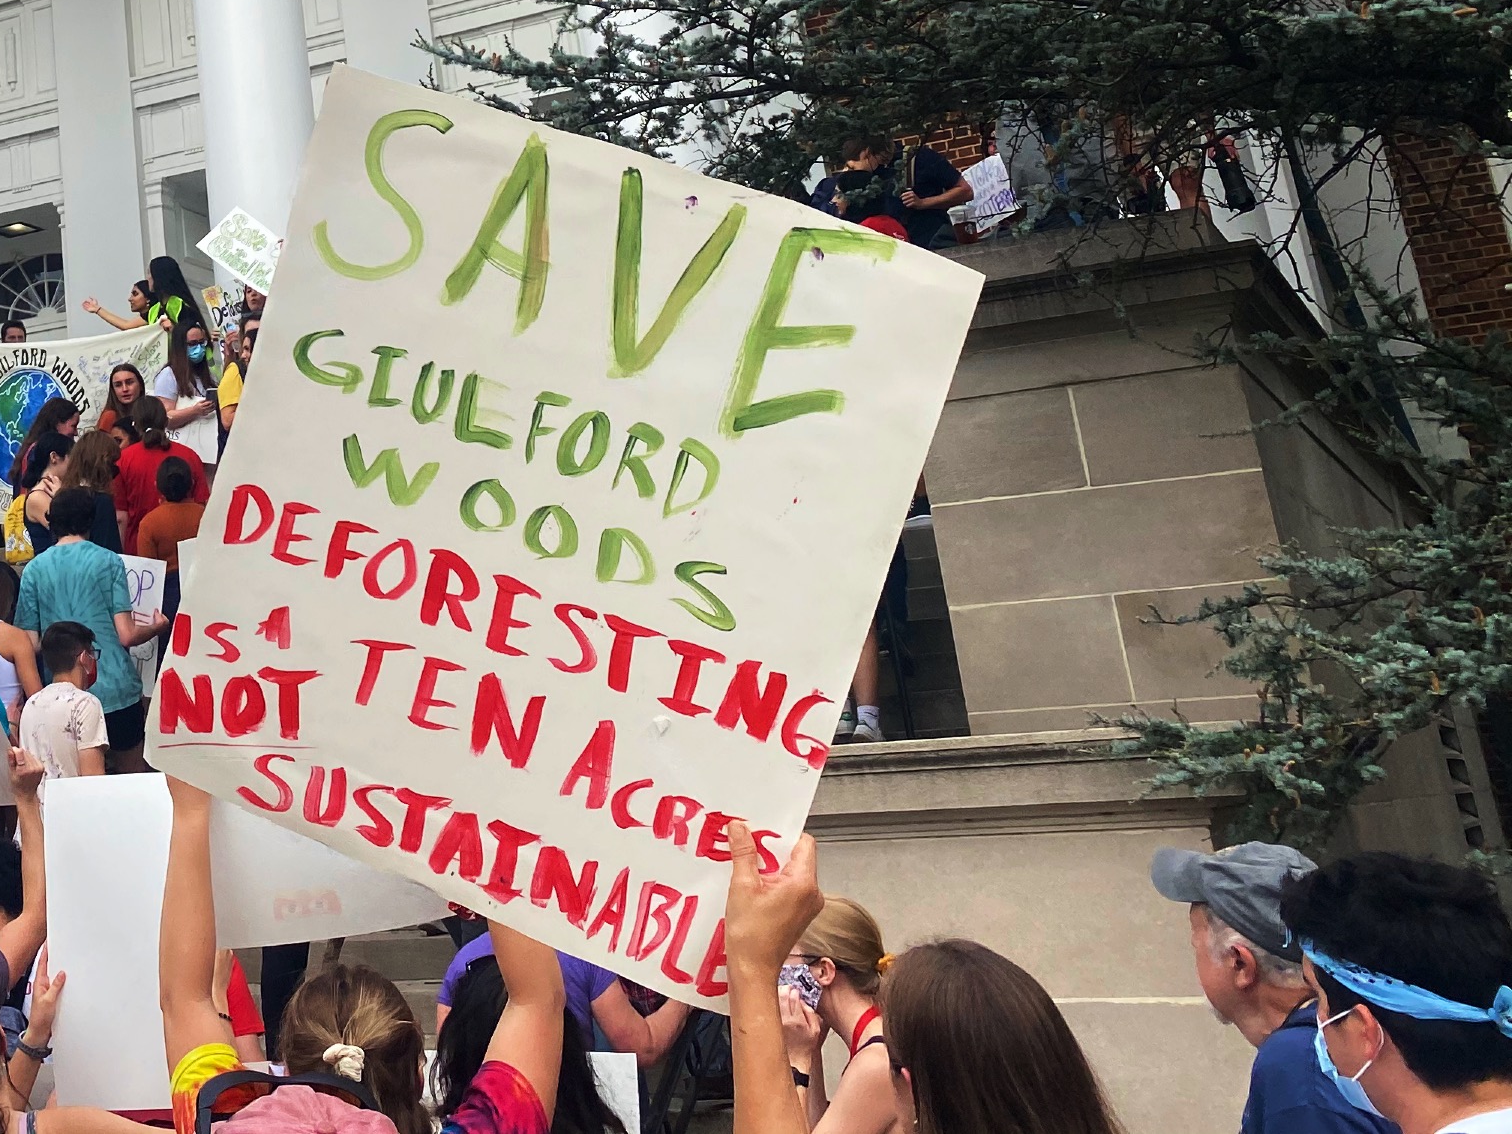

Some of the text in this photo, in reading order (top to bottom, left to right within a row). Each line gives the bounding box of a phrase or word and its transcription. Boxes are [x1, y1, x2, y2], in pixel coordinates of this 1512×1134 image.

[313, 109, 898, 441] SAVE
[51, 356, 90, 415] WOODS
[342, 433, 736, 632] WOODS
[158, 666, 324, 741] NOT
[173, 605, 291, 664] IS A
[222, 483, 835, 770] DEFORESTING
[350, 638, 547, 770] TEN
[235, 753, 729, 998] SUSTAINABLE
